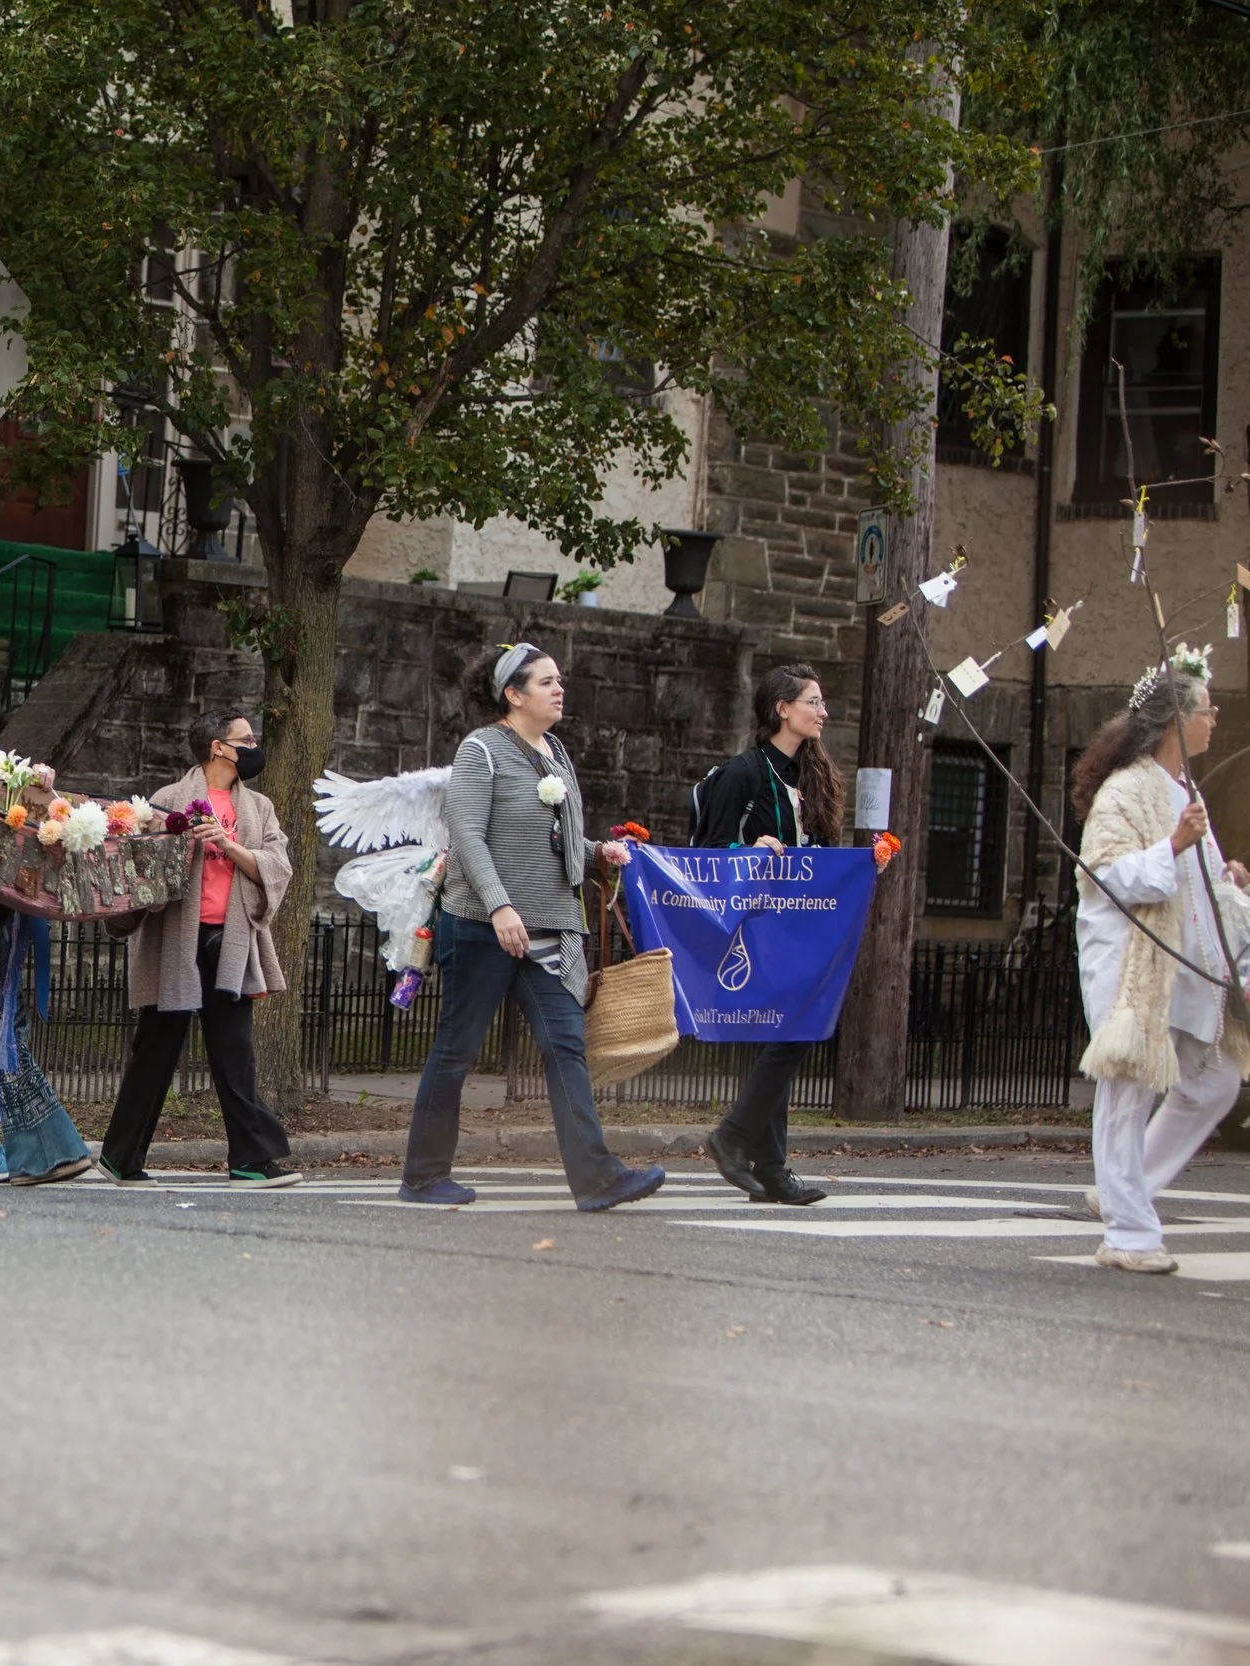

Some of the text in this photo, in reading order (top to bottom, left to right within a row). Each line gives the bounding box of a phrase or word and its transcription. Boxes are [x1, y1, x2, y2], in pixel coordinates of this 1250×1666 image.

[670, 855, 814, 883] SALT TRAILS
[651, 889, 837, 916] A Community Grief Experience
